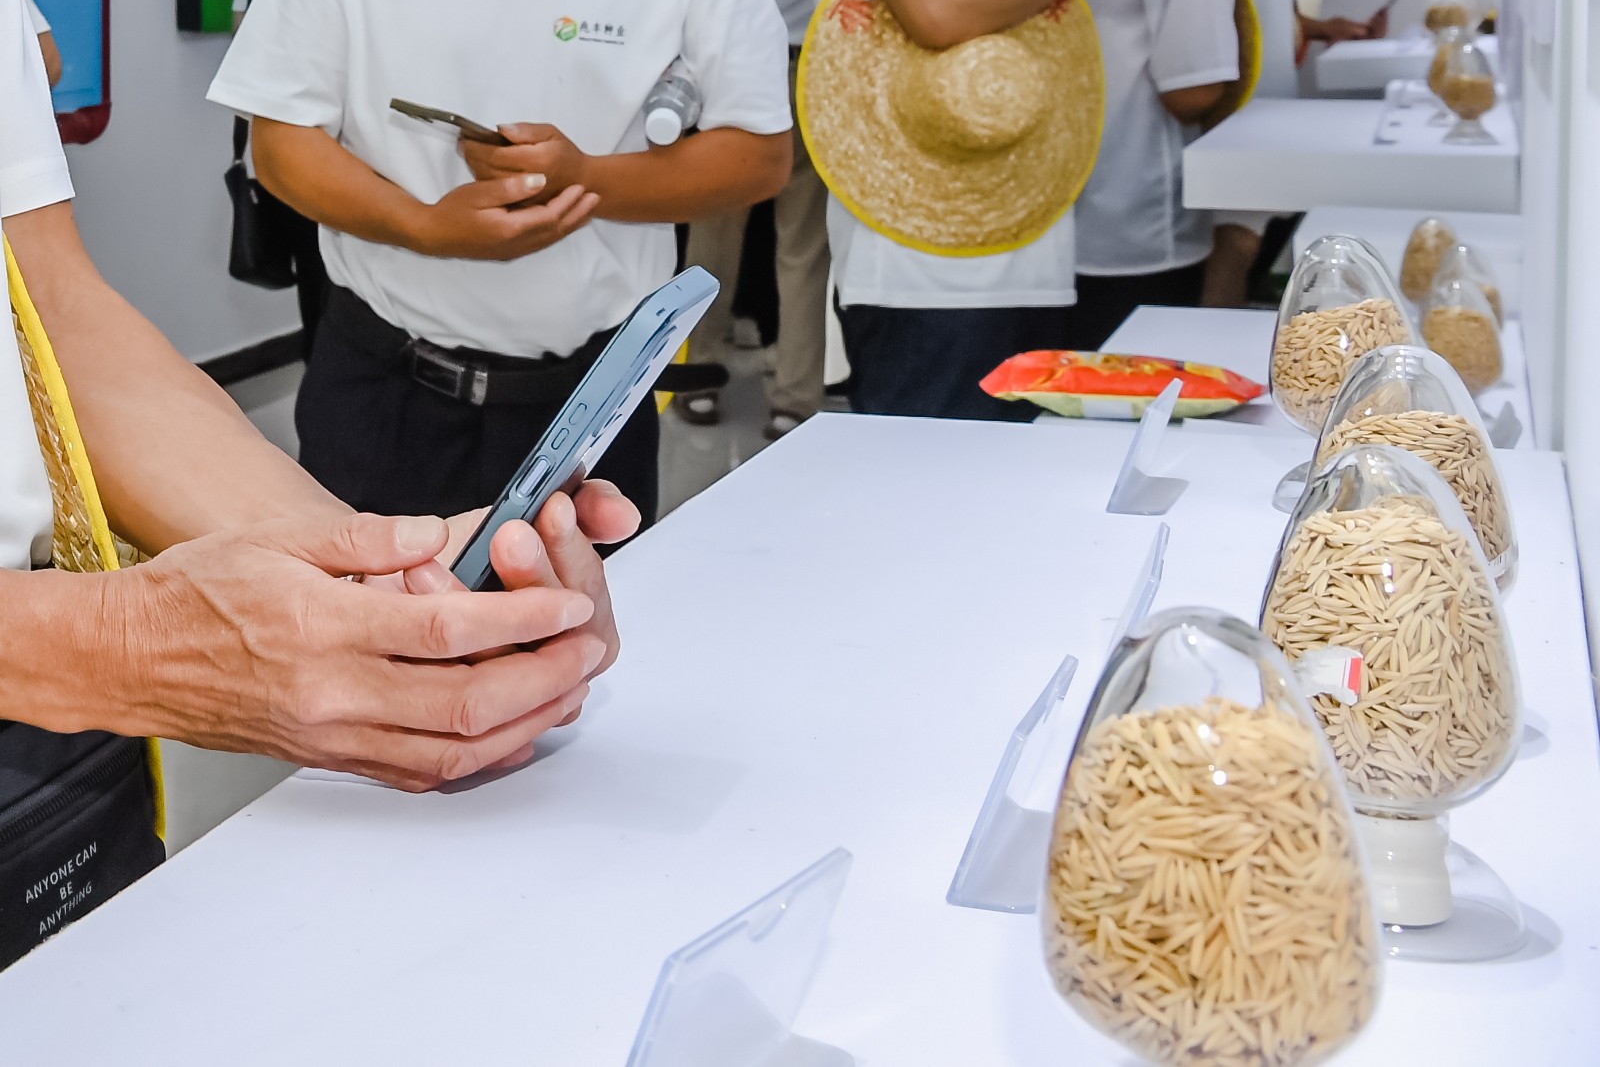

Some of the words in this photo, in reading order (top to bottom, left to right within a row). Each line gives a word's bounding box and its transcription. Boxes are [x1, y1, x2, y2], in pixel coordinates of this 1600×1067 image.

[25, 859, 75, 904] ANYONE
[75, 840, 97, 867] CAN
[59, 880, 73, 901] BE
[40, 880, 93, 935] ANYTHING
